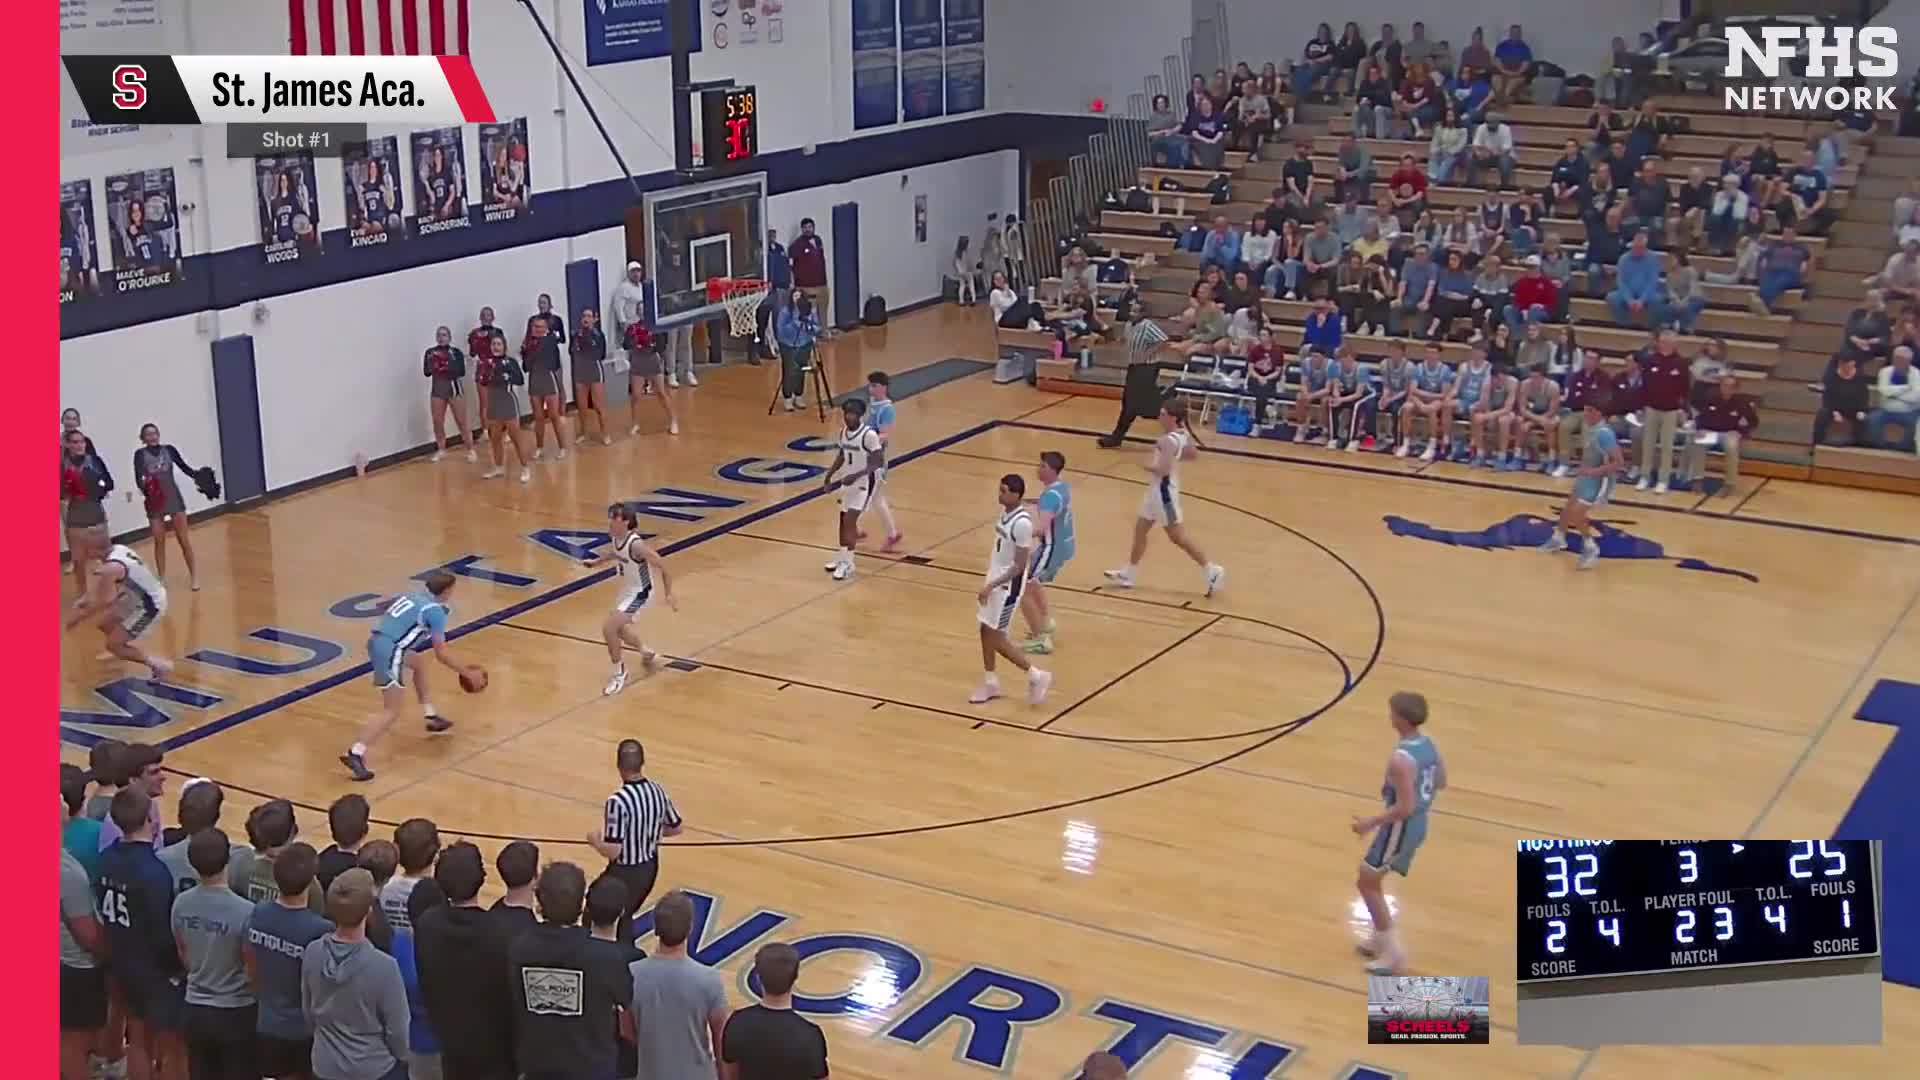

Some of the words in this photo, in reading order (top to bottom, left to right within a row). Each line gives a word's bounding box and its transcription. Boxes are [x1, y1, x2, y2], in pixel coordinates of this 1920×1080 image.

[485, 209, 515, 221] WINTER
[352, 232, 388, 248] KINCAID
[266, 248, 299, 264] WOODS
[118, 272, 171, 292] O'ROURKE
[1678, 850, 1699, 883] 3
[1789, 840, 1846, 878] 25
[1544, 853, 1599, 898] 32
[1755, 886, 1793, 901] T.O.L.
[1810, 880, 1856, 897] FOULS
[101, 888, 131, 928] 45
[1589, 900, 1626, 915] T.O.L.
[1644, 893, 1697, 910] PLAYER
[1699, 891, 1735, 906] FOUL
[1527, 903, 1571, 920] FOULS
[1764, 904, 1787, 933] 4
[1841, 899, 1851, 929] 1
[1546, 920, 1567, 953] 2
[1598, 918, 1621, 946] 4
[1813, 937, 1860, 954] SCORE
[1670, 949, 1719, 965] MATCH
[1531, 960, 1577, 976] SCORE
